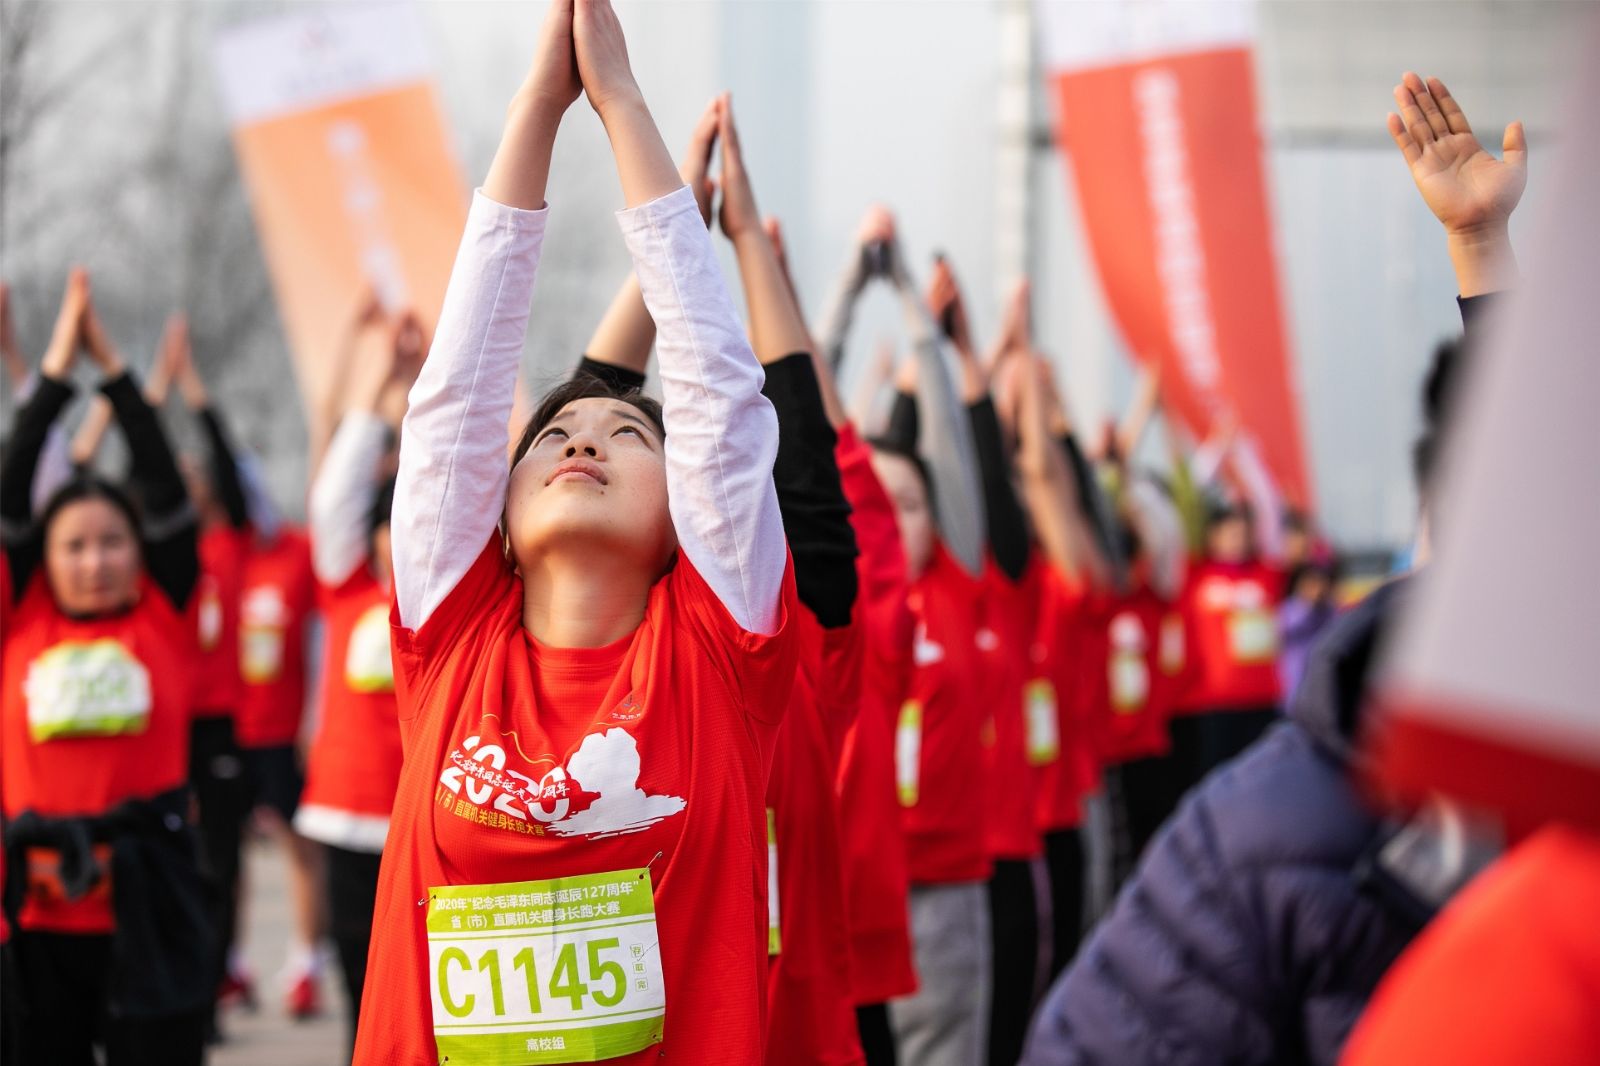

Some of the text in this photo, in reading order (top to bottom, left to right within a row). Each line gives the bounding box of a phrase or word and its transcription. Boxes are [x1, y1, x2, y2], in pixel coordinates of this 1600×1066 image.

[438, 937, 627, 1018] C1145
[526, 1036, 566, 1051] 高校组
